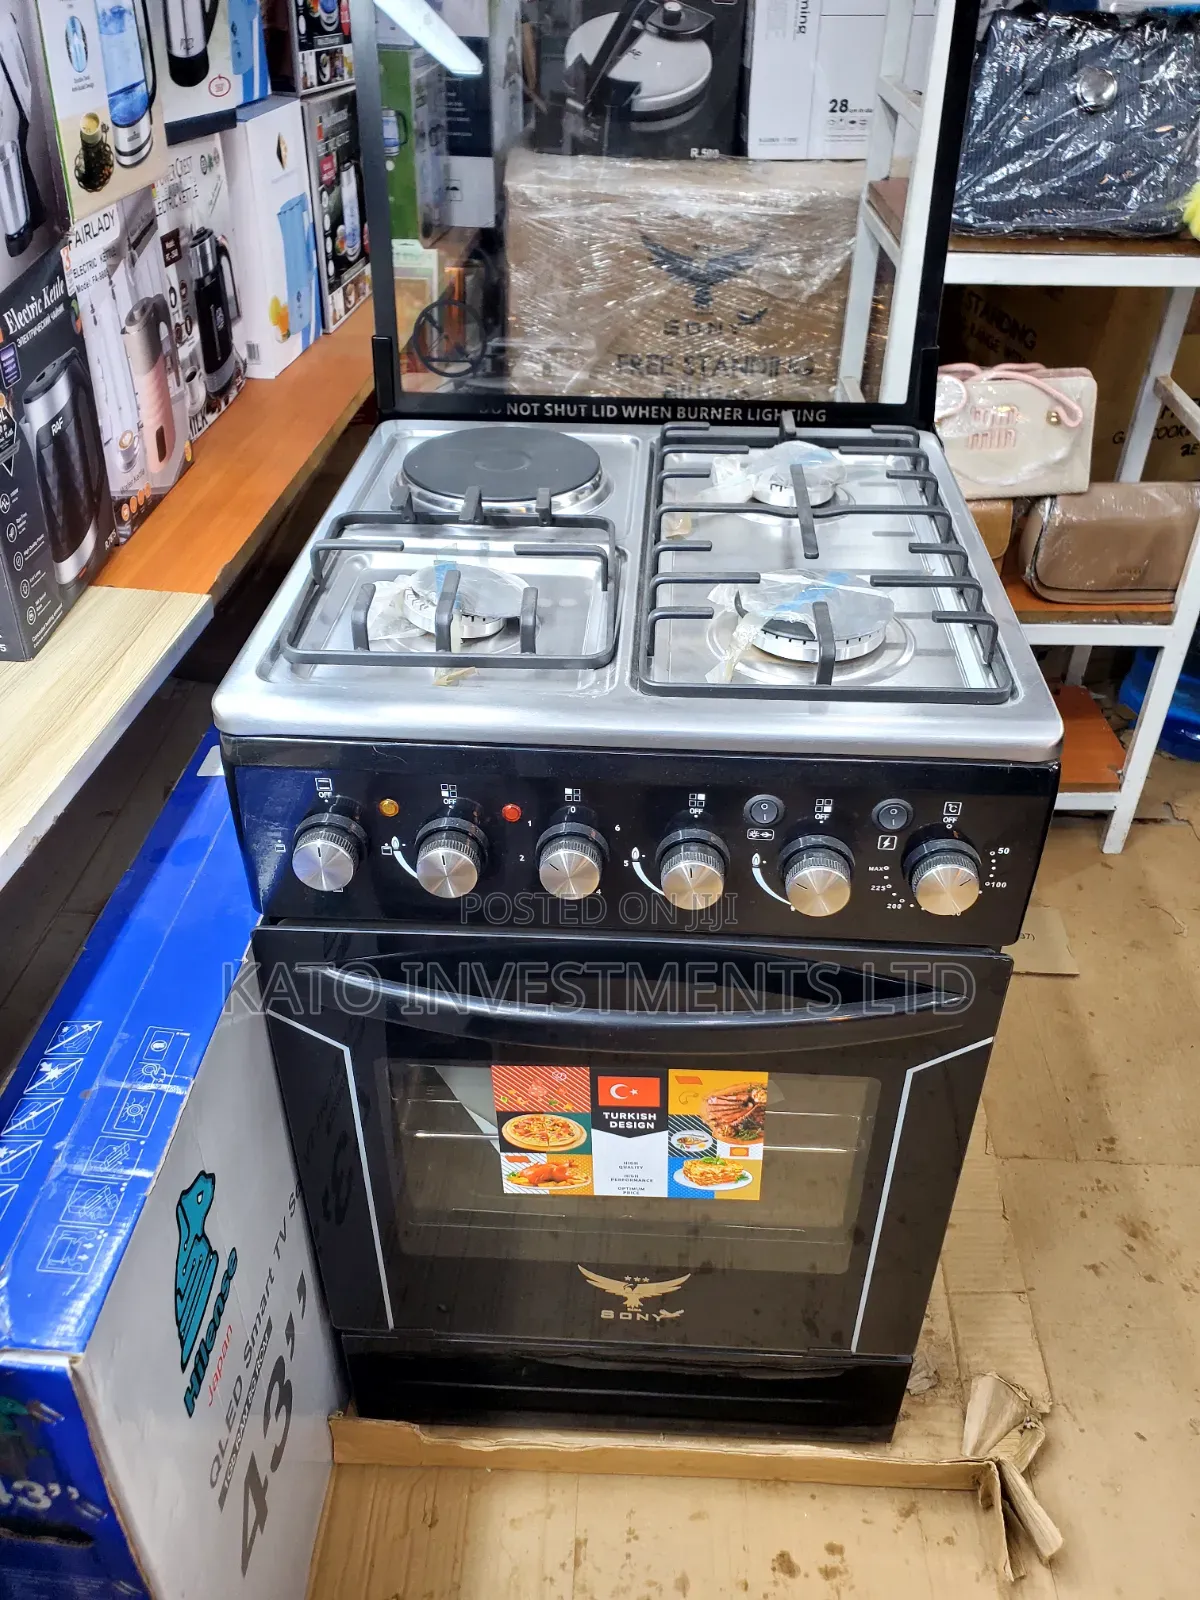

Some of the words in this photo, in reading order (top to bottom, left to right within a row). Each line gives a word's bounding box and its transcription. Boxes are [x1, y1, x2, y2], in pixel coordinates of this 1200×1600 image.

[829, 99, 848, 113] 28
[72, 257, 98, 279] ELECTRIC
[3, 295, 43, 335] Electric
[616, 354, 674, 375] FREE
[506, 402, 541, 416] NOT
[544, 403, 588, 417] SHUT
[591, 404, 618, 418] LID
[621, 405, 672, 419] WHEN
[676, 406, 742, 421] BURNER
[51, 416, 63, 436] RAF
[997, 846, 1010, 855] 50
[603, 1112, 657, 1121] TURKISH
[609, 1121, 655, 1130] DESIGN
[600, 1309, 668, 1322] SONY
[209, 1375, 243, 1490] QLED
[243, 1267, 275, 1369] Smart
[273, 1216, 287, 1261] TV
[208, 1324, 233, 1406] Japan
